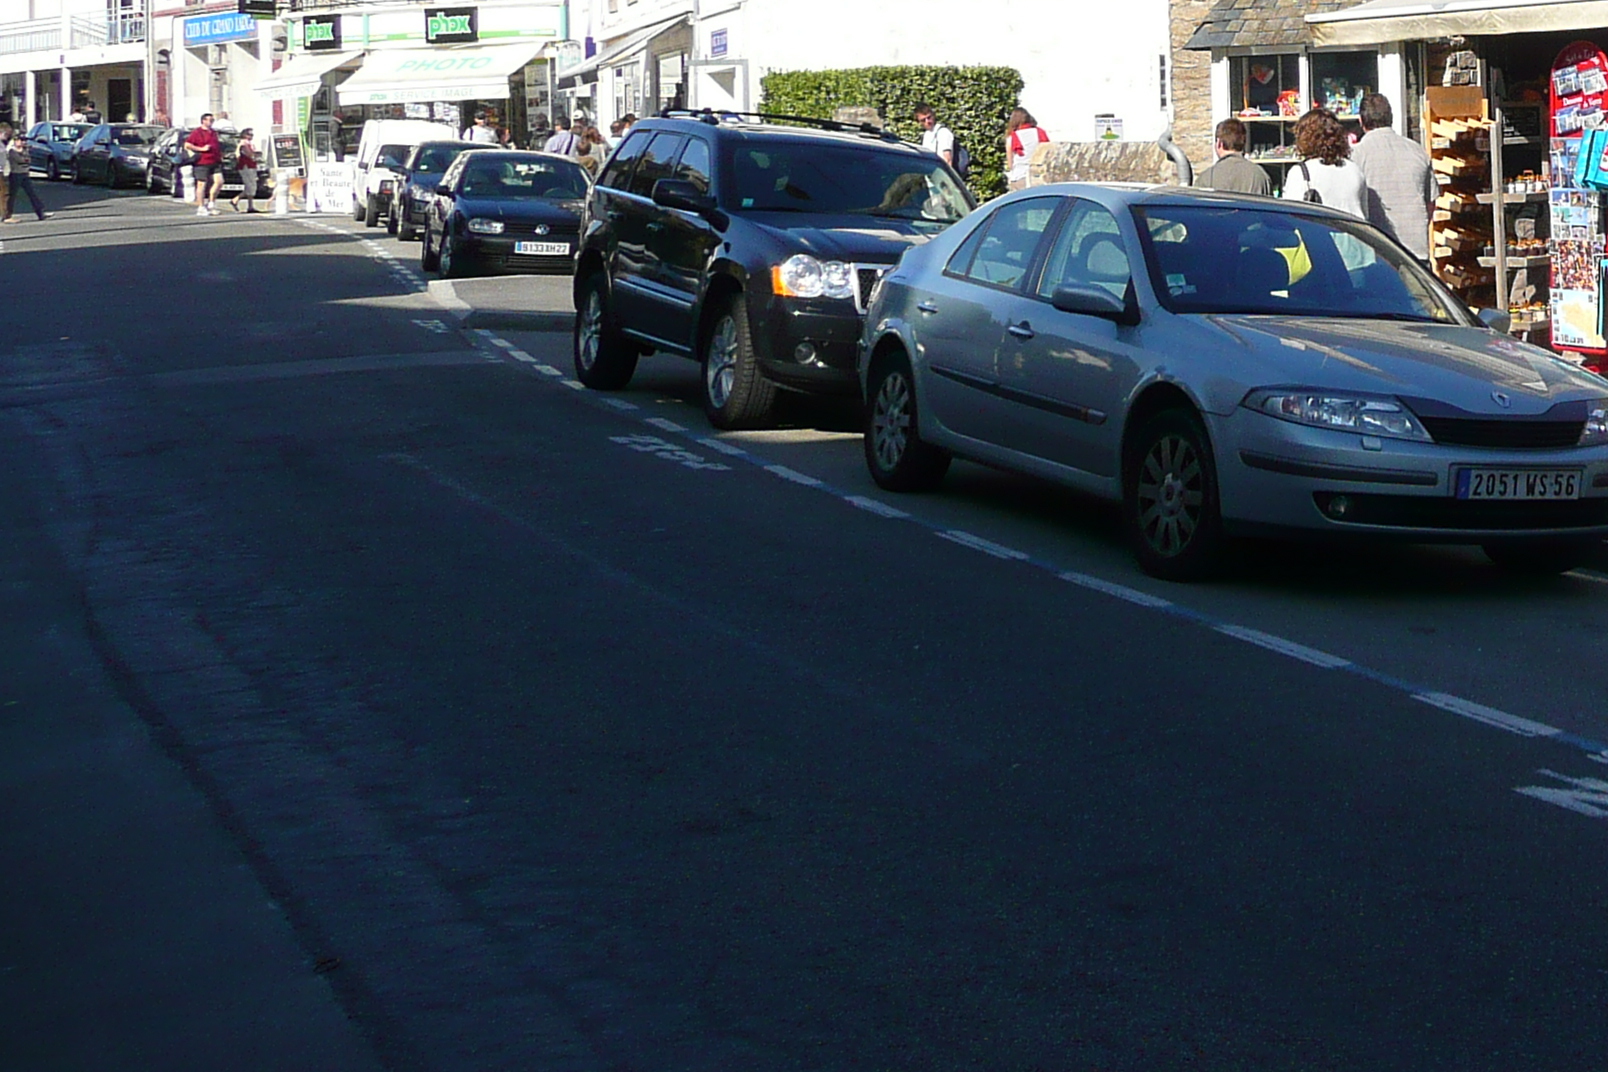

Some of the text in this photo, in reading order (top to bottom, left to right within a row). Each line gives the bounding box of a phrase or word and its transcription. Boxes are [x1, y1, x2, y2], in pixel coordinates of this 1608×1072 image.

[305, 20, 334, 46] phox
[428, 12, 472, 39] phox
[395, 57, 493, 72] PHOTO
[393, 89, 437, 101] SERVICE
[441, 87, 476, 98] IMAGE
[1472, 473, 1576, 496] 2051 WS 56
